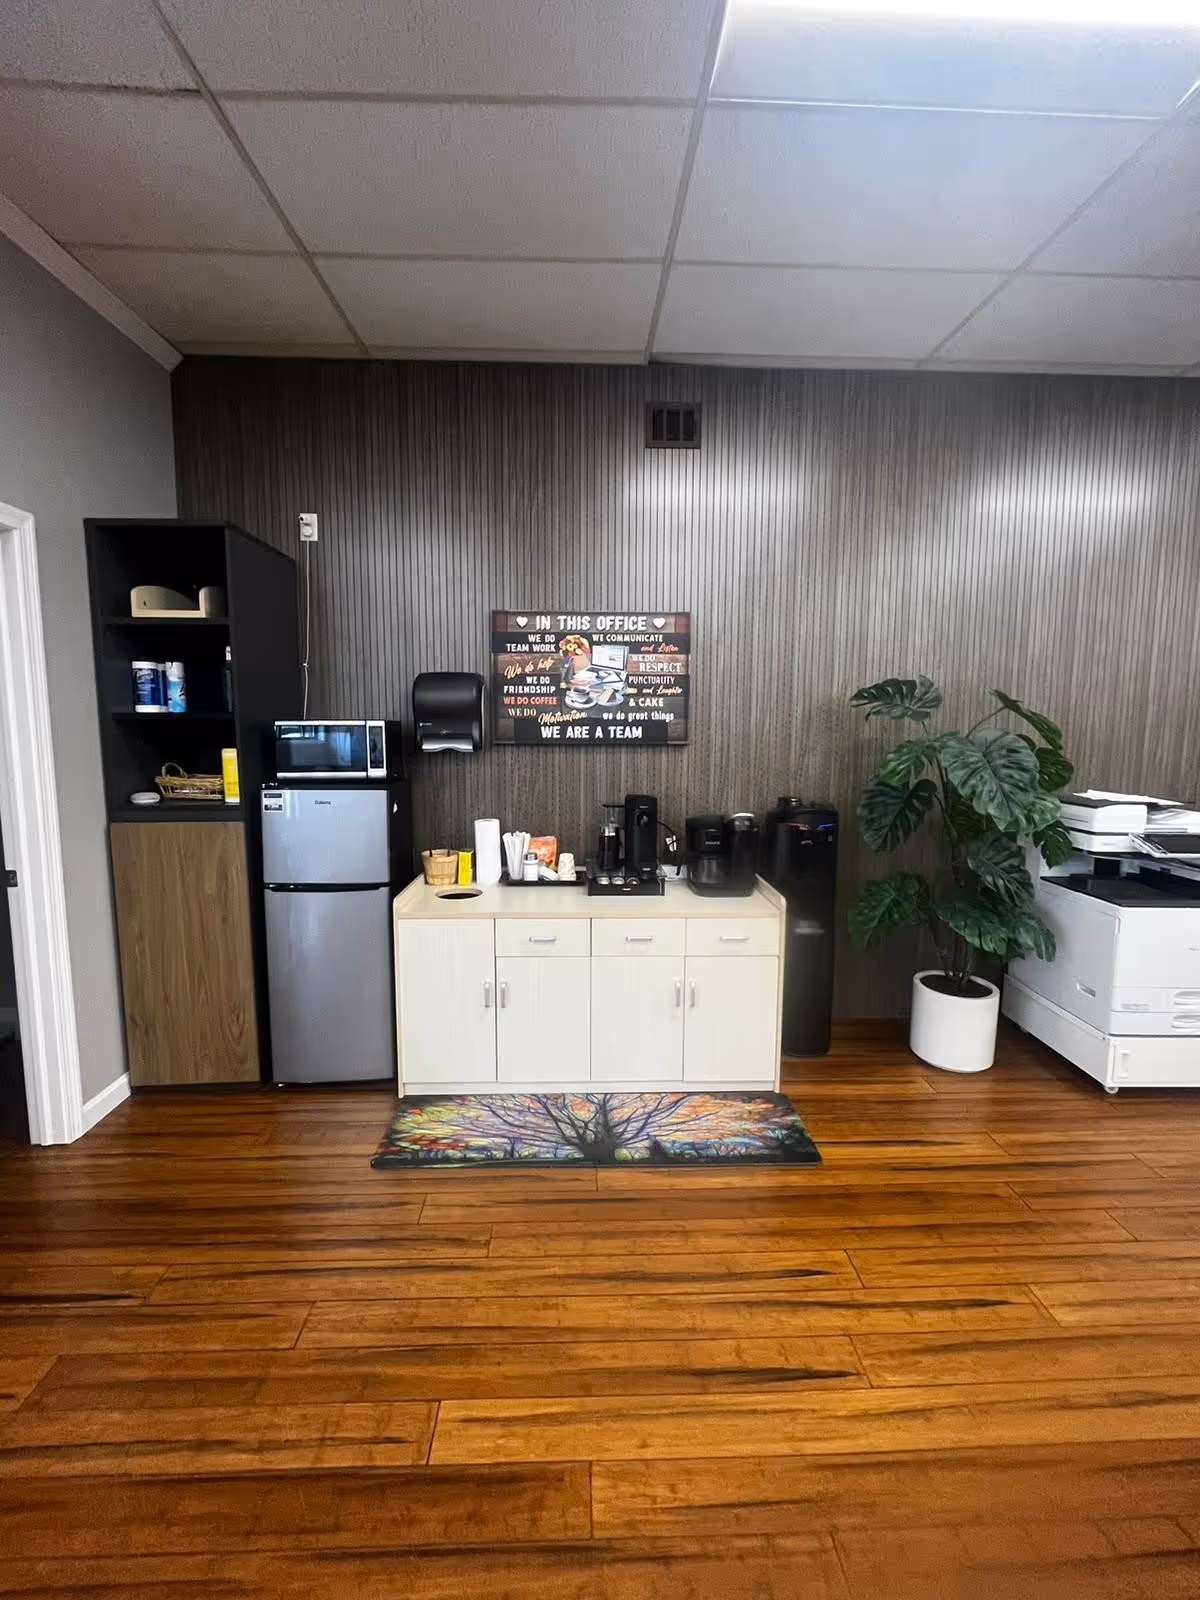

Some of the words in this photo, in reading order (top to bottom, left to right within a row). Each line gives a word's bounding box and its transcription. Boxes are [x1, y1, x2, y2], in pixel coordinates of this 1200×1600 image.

[535, 615, 551, 630] IN
[557, 615, 591, 631] THIS
[596, 615, 647, 631] OFFICE
[528, 634, 541, 643] WE
[545, 634, 555, 643] DO
[592, 633, 604, 642] WE
[606, 634, 663, 642] COMMUNICATE
[506, 643, 529, 652] TEAM
[533, 643, 556, 652] WORK
[504, 663, 522, 679] We
[525, 660, 534, 674] do
[537, 655, 554, 671] help
[639, 662, 682, 673] RESPECT
[526, 676, 537, 684] WE
[540, 676, 550, 684] DO
[628, 675, 676, 685] PUNCTUALITY
[503, 685, 556, 694] FRIENDSHIP
[503, 696, 515, 705] WE
[517, 696, 528, 705] DO
[530, 696, 557, 705] COFFEE
[628, 698, 636, 707] &
[638, 698, 664, 707] CAKE
[508, 708, 522, 717] WE
[524, 708, 537, 717] DO
[538, 709, 588, 725] Motivation
[602, 712, 613, 720] we
[616, 711, 625, 720] do
[627, 711, 648, 722] great
[651, 710, 674, 722] things
[540, 726, 561, 739] WE
[566, 726, 590, 739] ARE
[595, 726, 604, 739] A
[608, 726, 643, 739] TEAM
